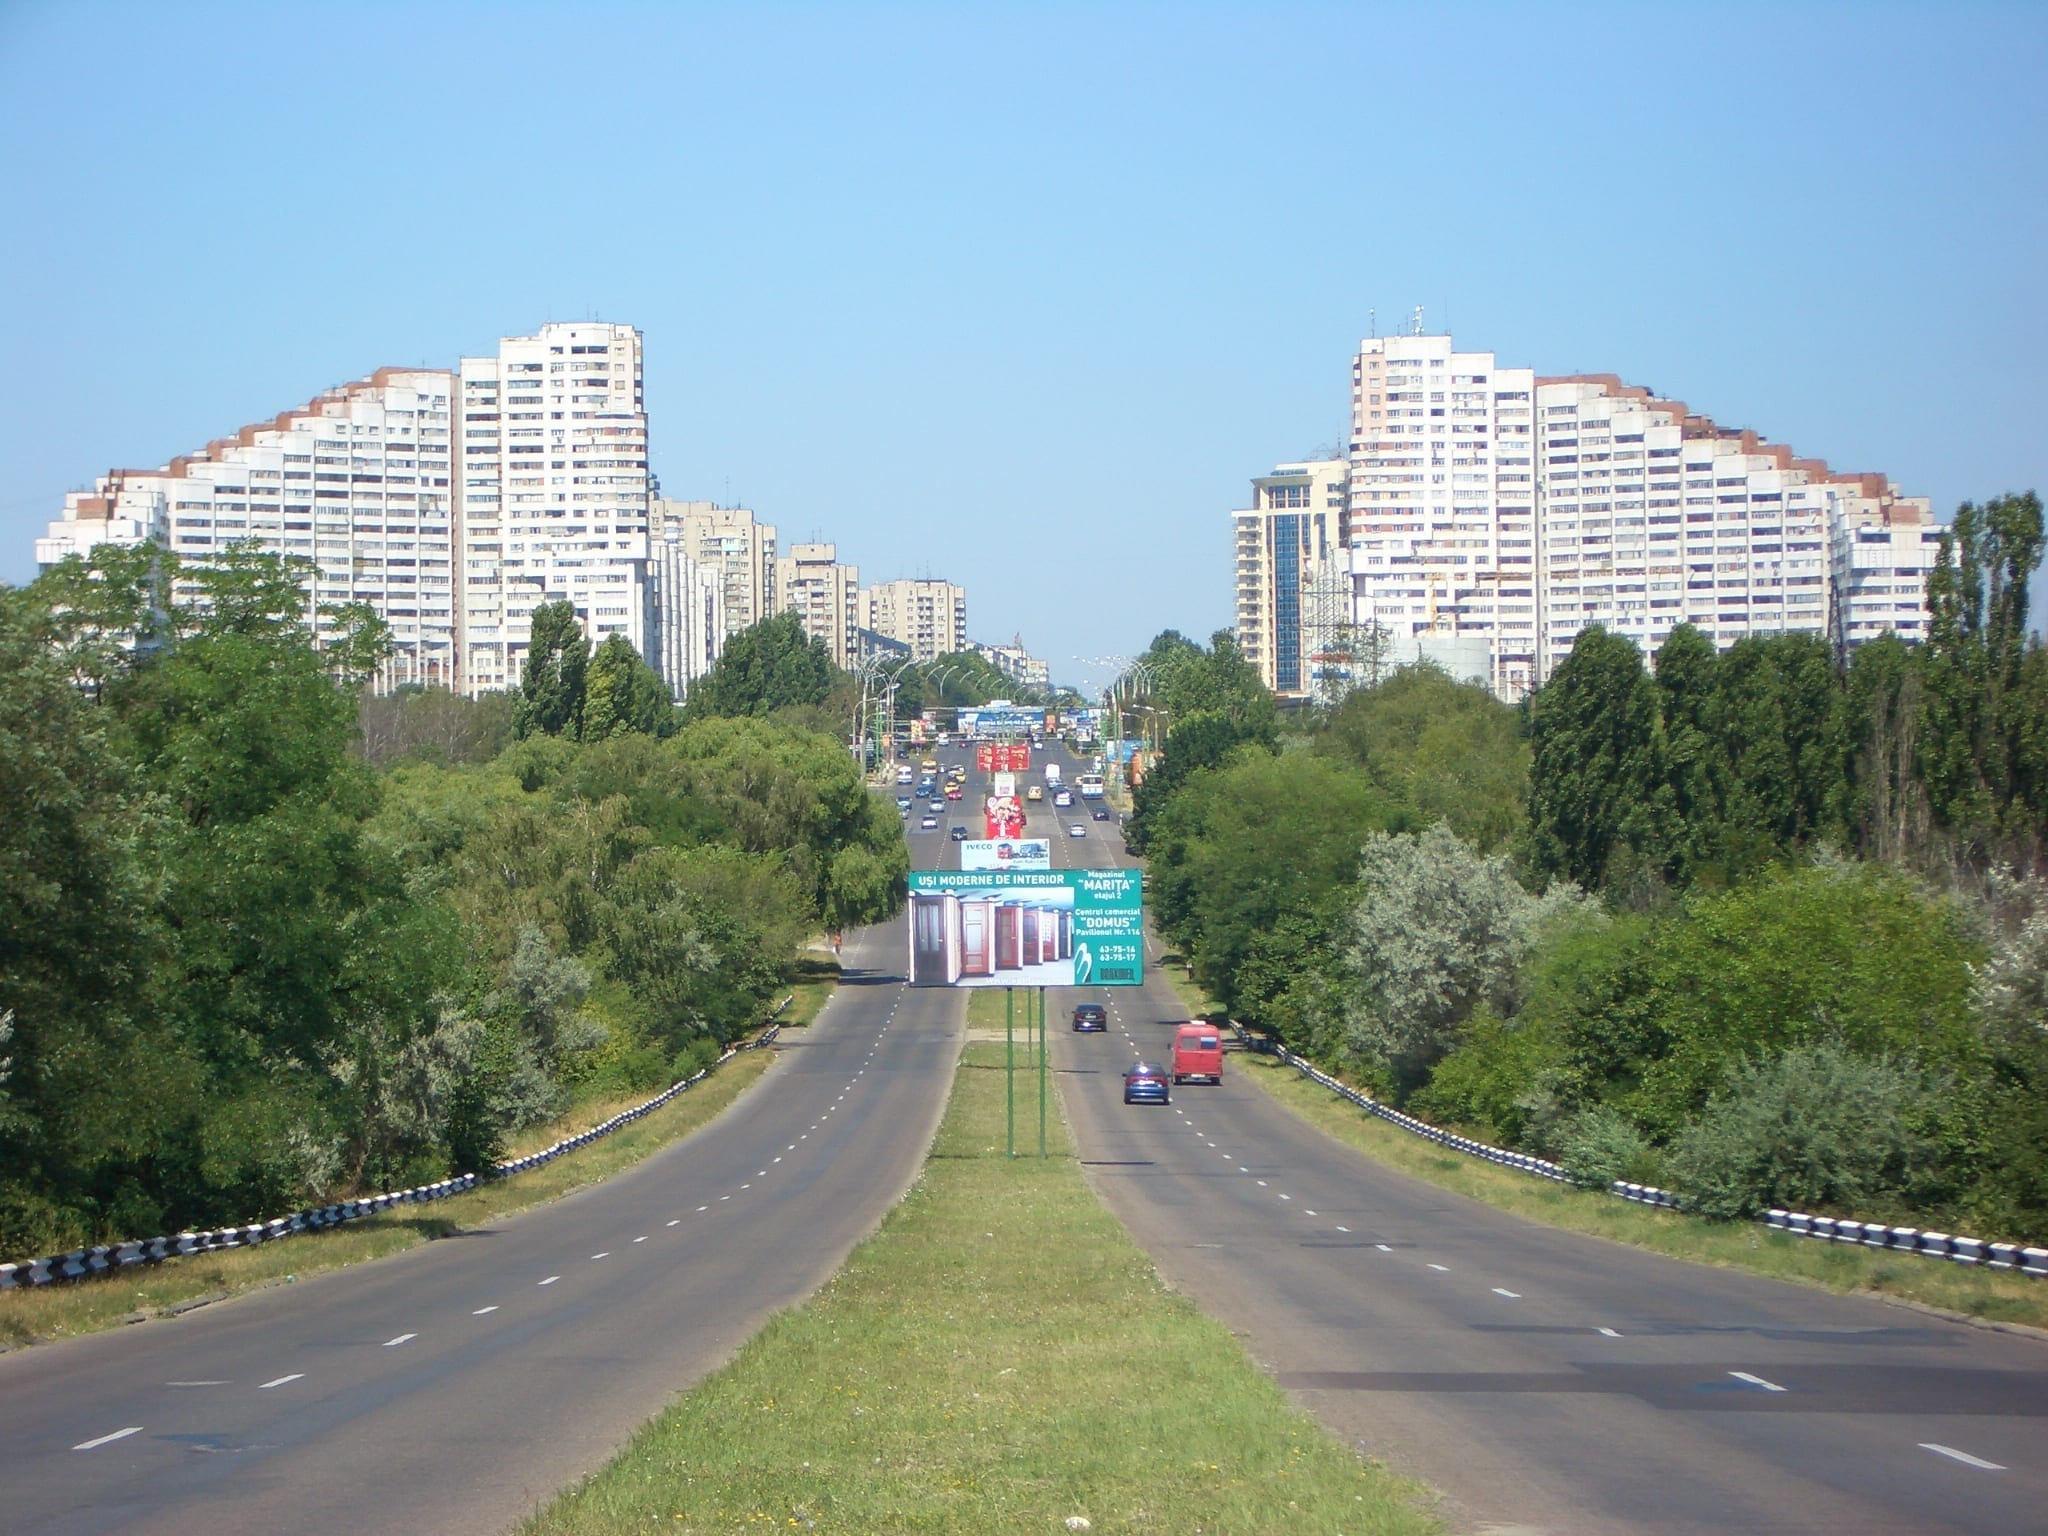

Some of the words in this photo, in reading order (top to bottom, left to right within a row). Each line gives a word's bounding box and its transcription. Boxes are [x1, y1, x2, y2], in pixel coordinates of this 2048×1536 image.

[939, 875, 993, 885] MODERNE
[995, 874, 1011, 885] DE
[1013, 874, 1065, 884] INTERIOR
[1075, 908, 1103, 916] Centrul
